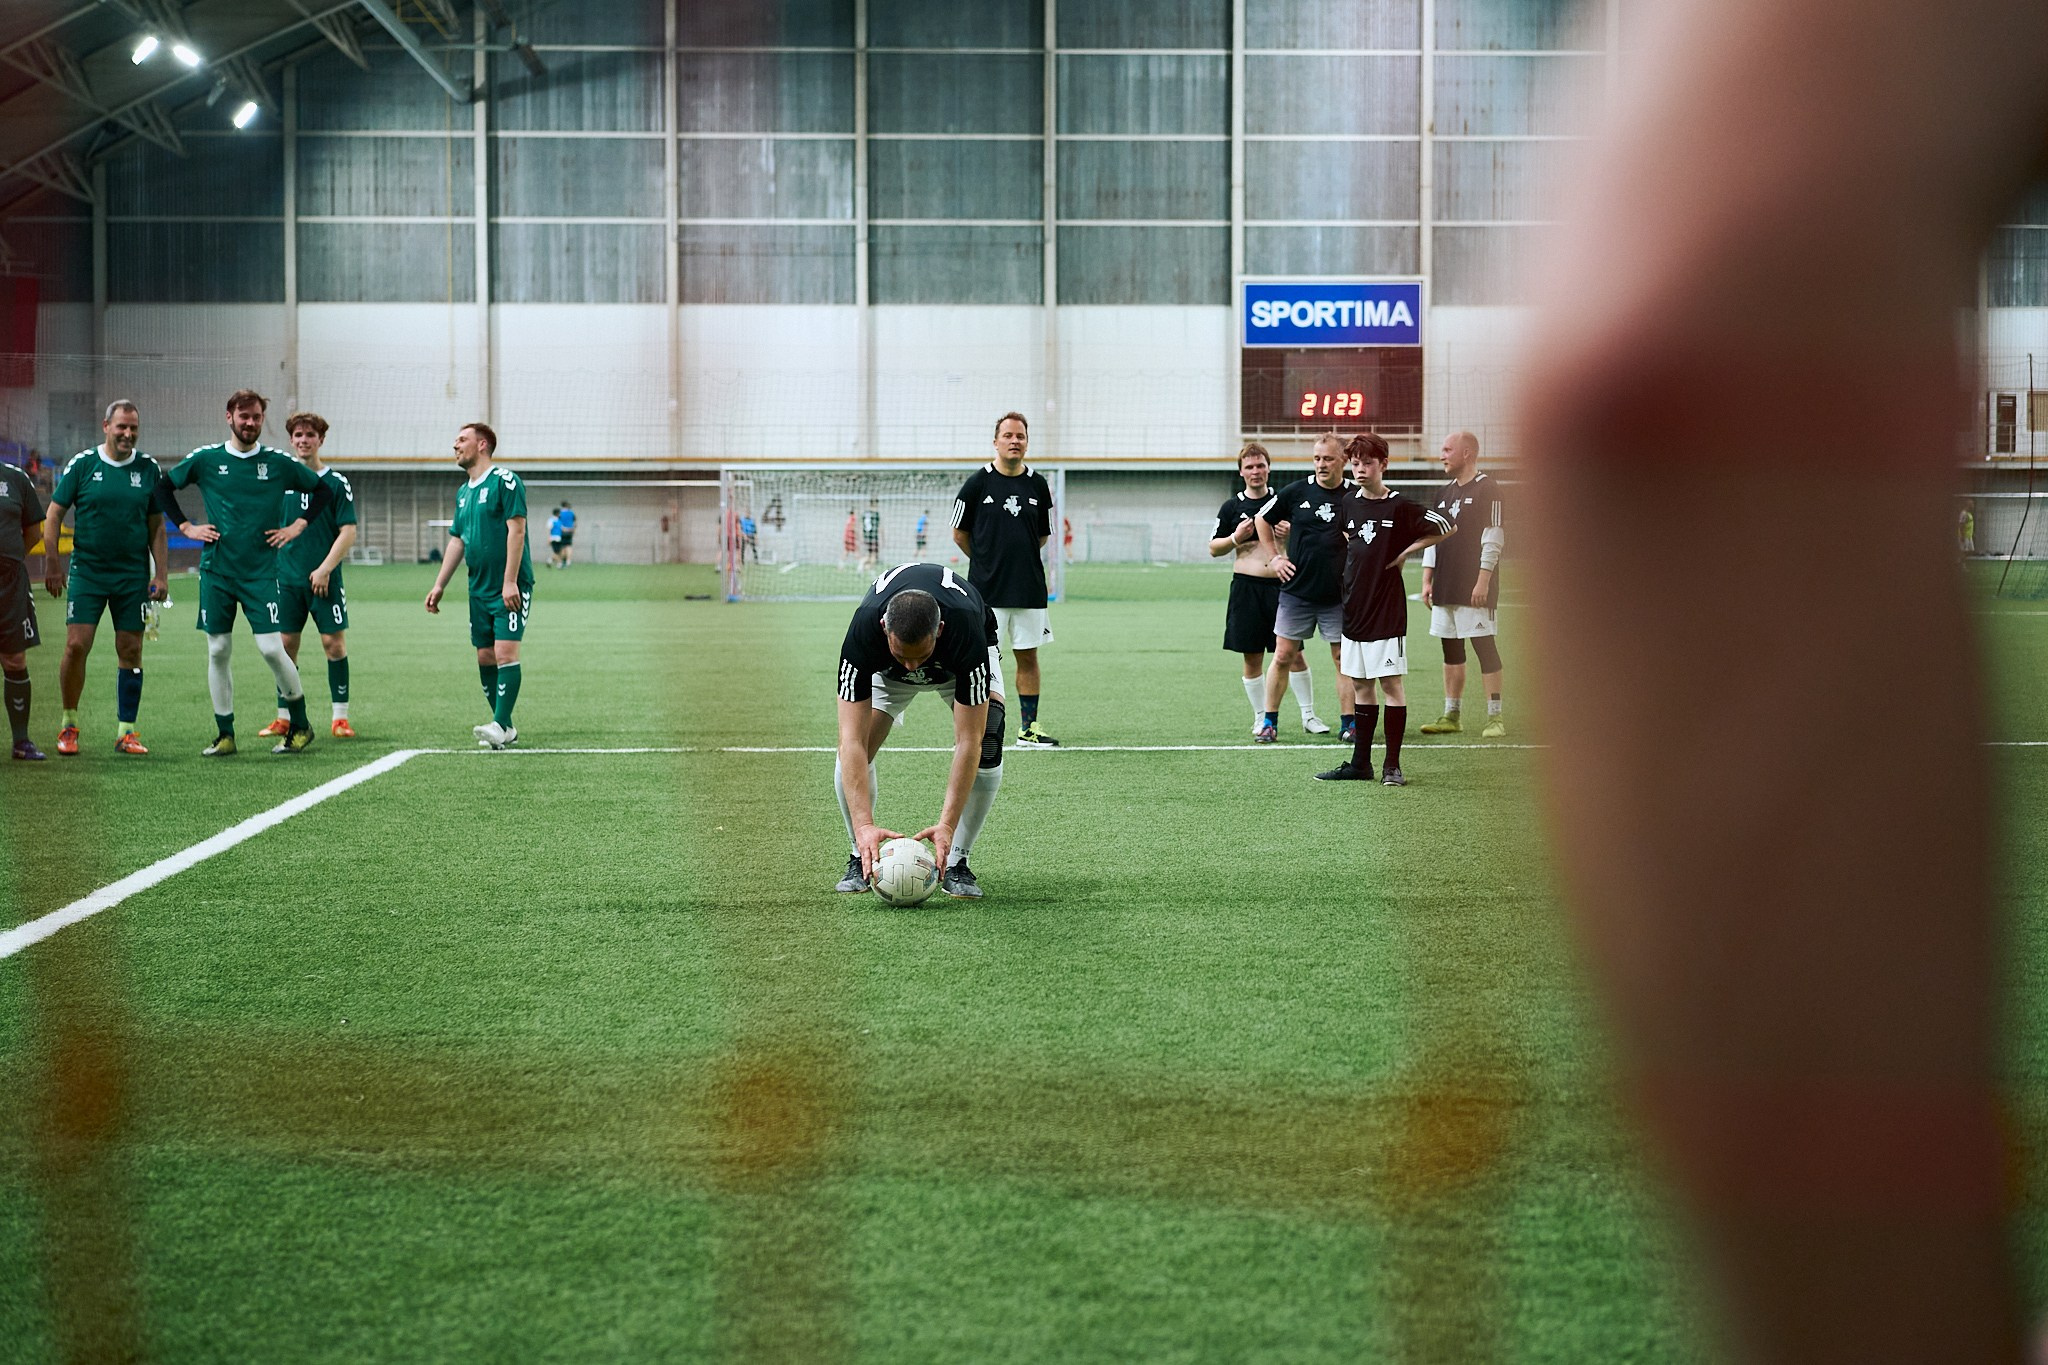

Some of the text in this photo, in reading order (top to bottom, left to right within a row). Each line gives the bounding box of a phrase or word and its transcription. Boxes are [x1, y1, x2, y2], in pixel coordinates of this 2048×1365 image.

[1251, 300, 1414, 328] SPORTIMA
[266, 602, 280, 624] 12
[332, 604, 343, 624] 9
[508, 611, 518, 632] 8
[22, 617, 35, 640] 13
